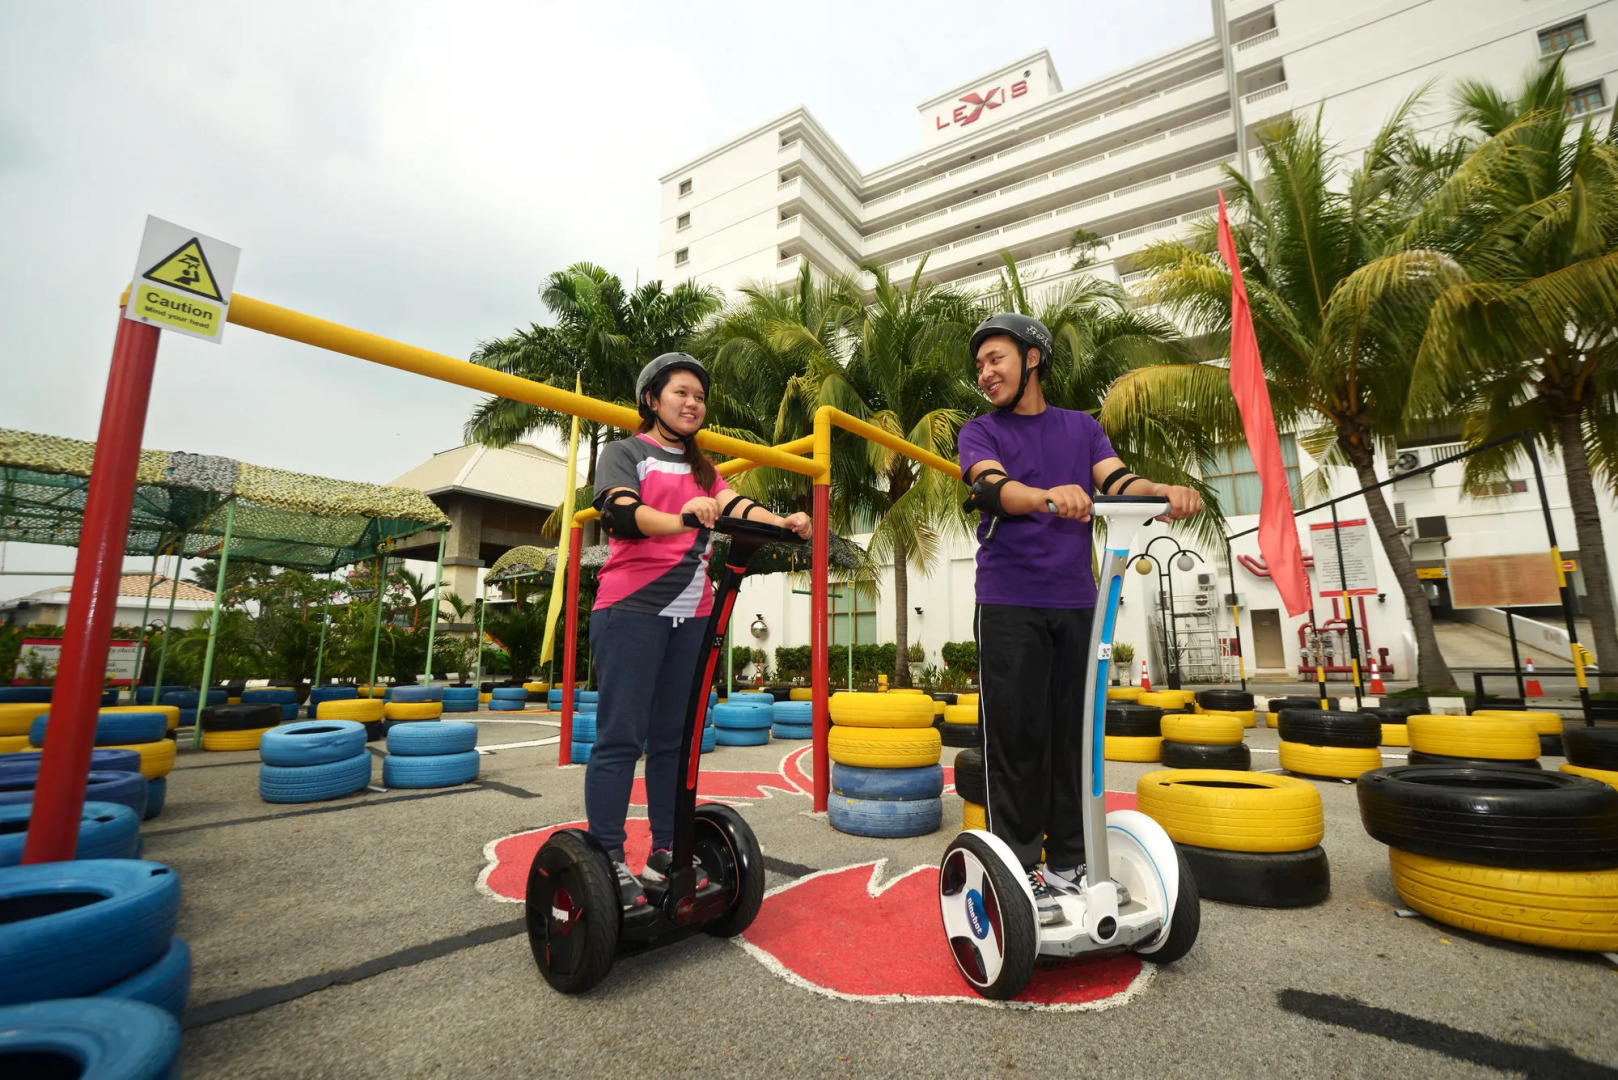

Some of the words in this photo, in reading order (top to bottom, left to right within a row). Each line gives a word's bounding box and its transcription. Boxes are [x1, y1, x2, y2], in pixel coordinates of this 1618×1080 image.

[936, 79, 1028, 130] LEXIS
[144, 305, 166, 317] Mind
[168, 312, 188, 323] your
[189, 318, 210, 330] head
[146, 292, 213, 320] Caution
[967, 897, 983, 934] ninebot
